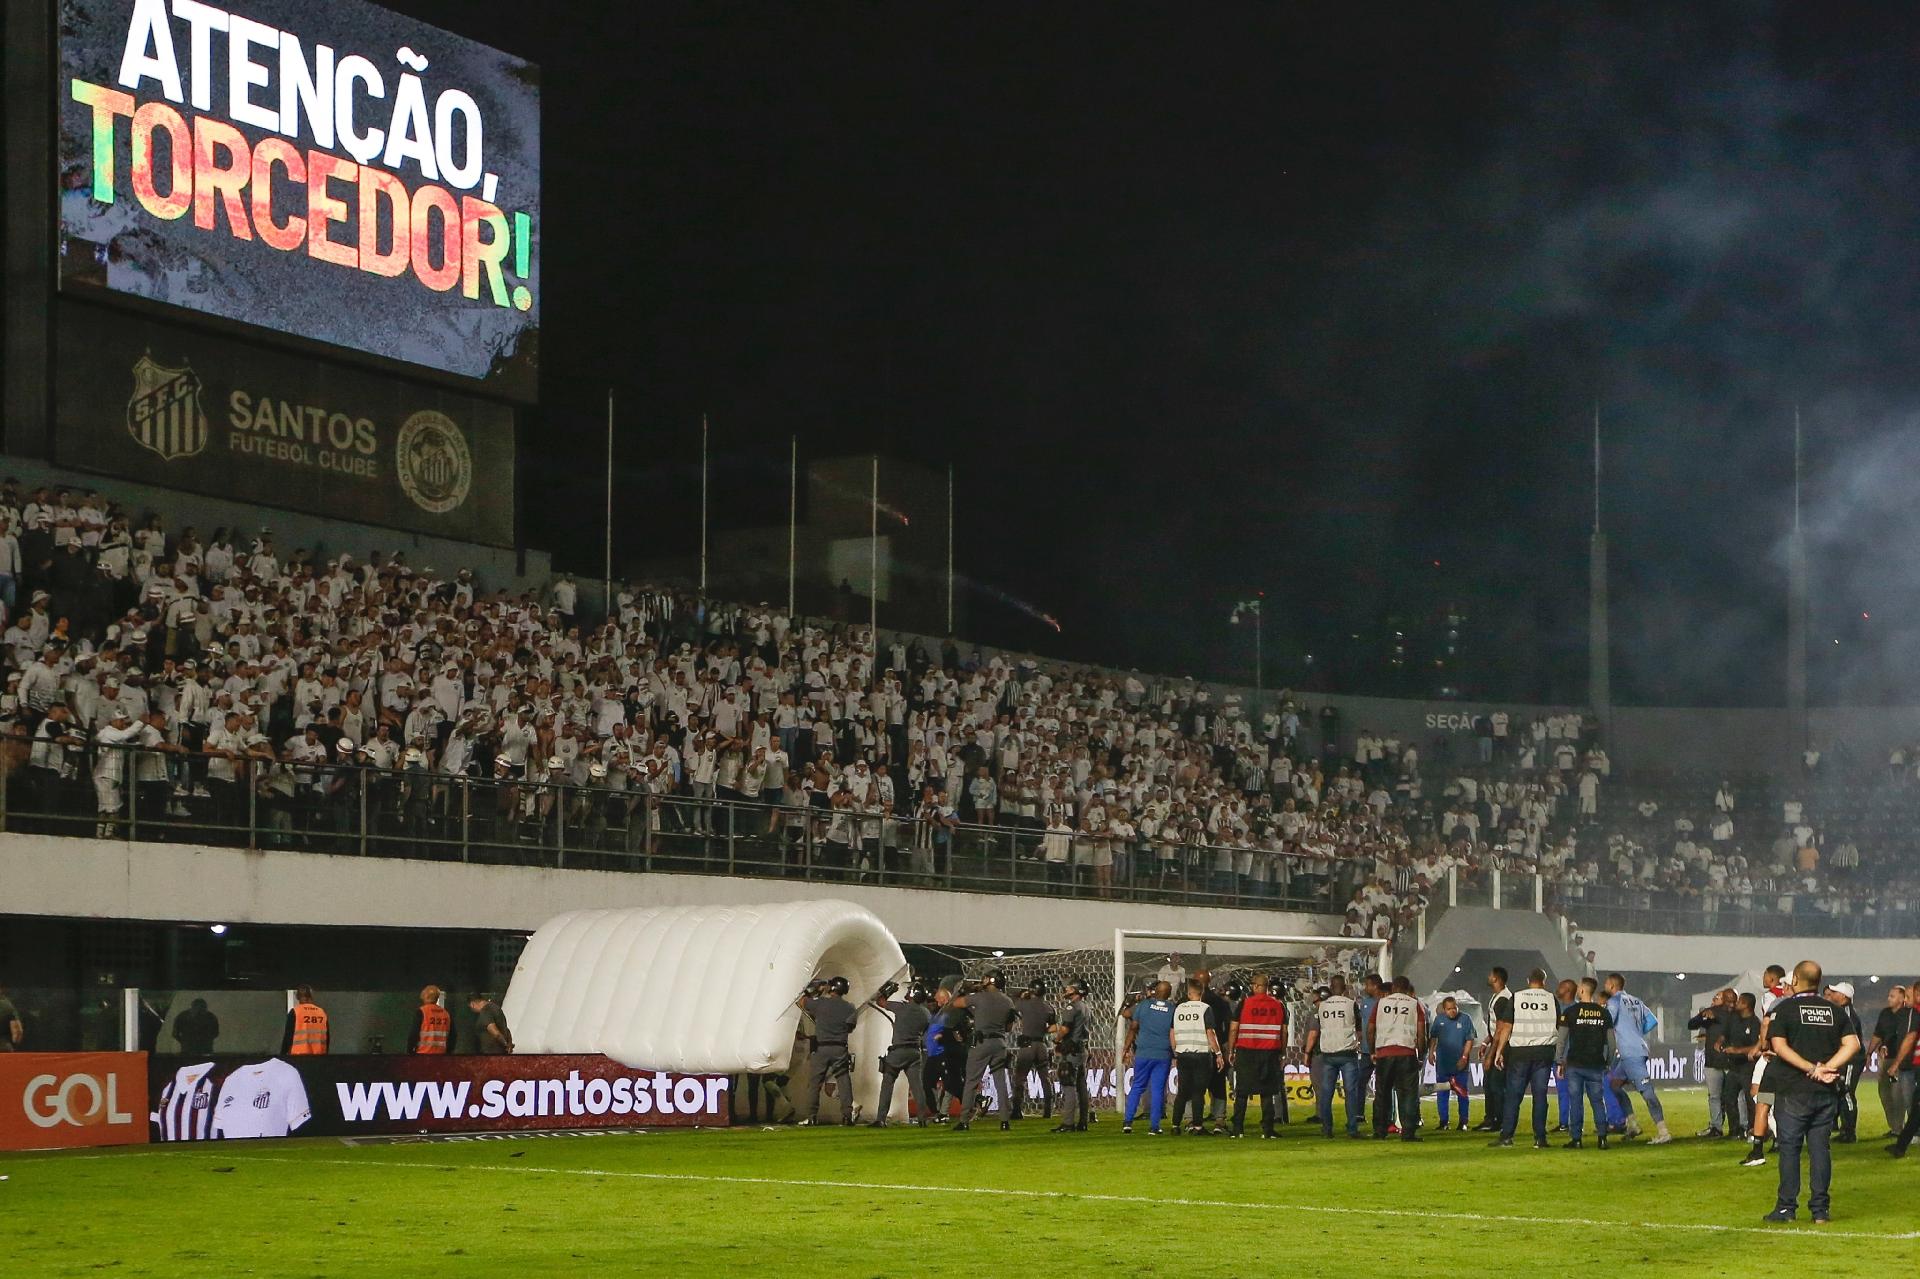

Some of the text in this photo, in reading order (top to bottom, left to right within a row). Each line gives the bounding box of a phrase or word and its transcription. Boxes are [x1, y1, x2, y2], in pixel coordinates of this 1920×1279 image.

[118, 0, 498, 204] ATENÇÃO,
[71, 78, 532, 311] TORCEDOR!
[229, 390, 377, 455] SANTOS
[229, 431, 378, 478] FUTEBOL CLUBE
[303, 1015, 324, 1023] 287
[1178, 1013, 1200, 1021] 009
[1322, 1010, 1345, 1019] 015
[1383, 1005, 1409, 1015] 012
[1520, 1001, 1549, 1011] 003
[1807, 1015, 1827, 1023] CIVIL
[23, 1073, 132, 1128] GOL
[336, 1070, 729, 1121] www.santosstor
